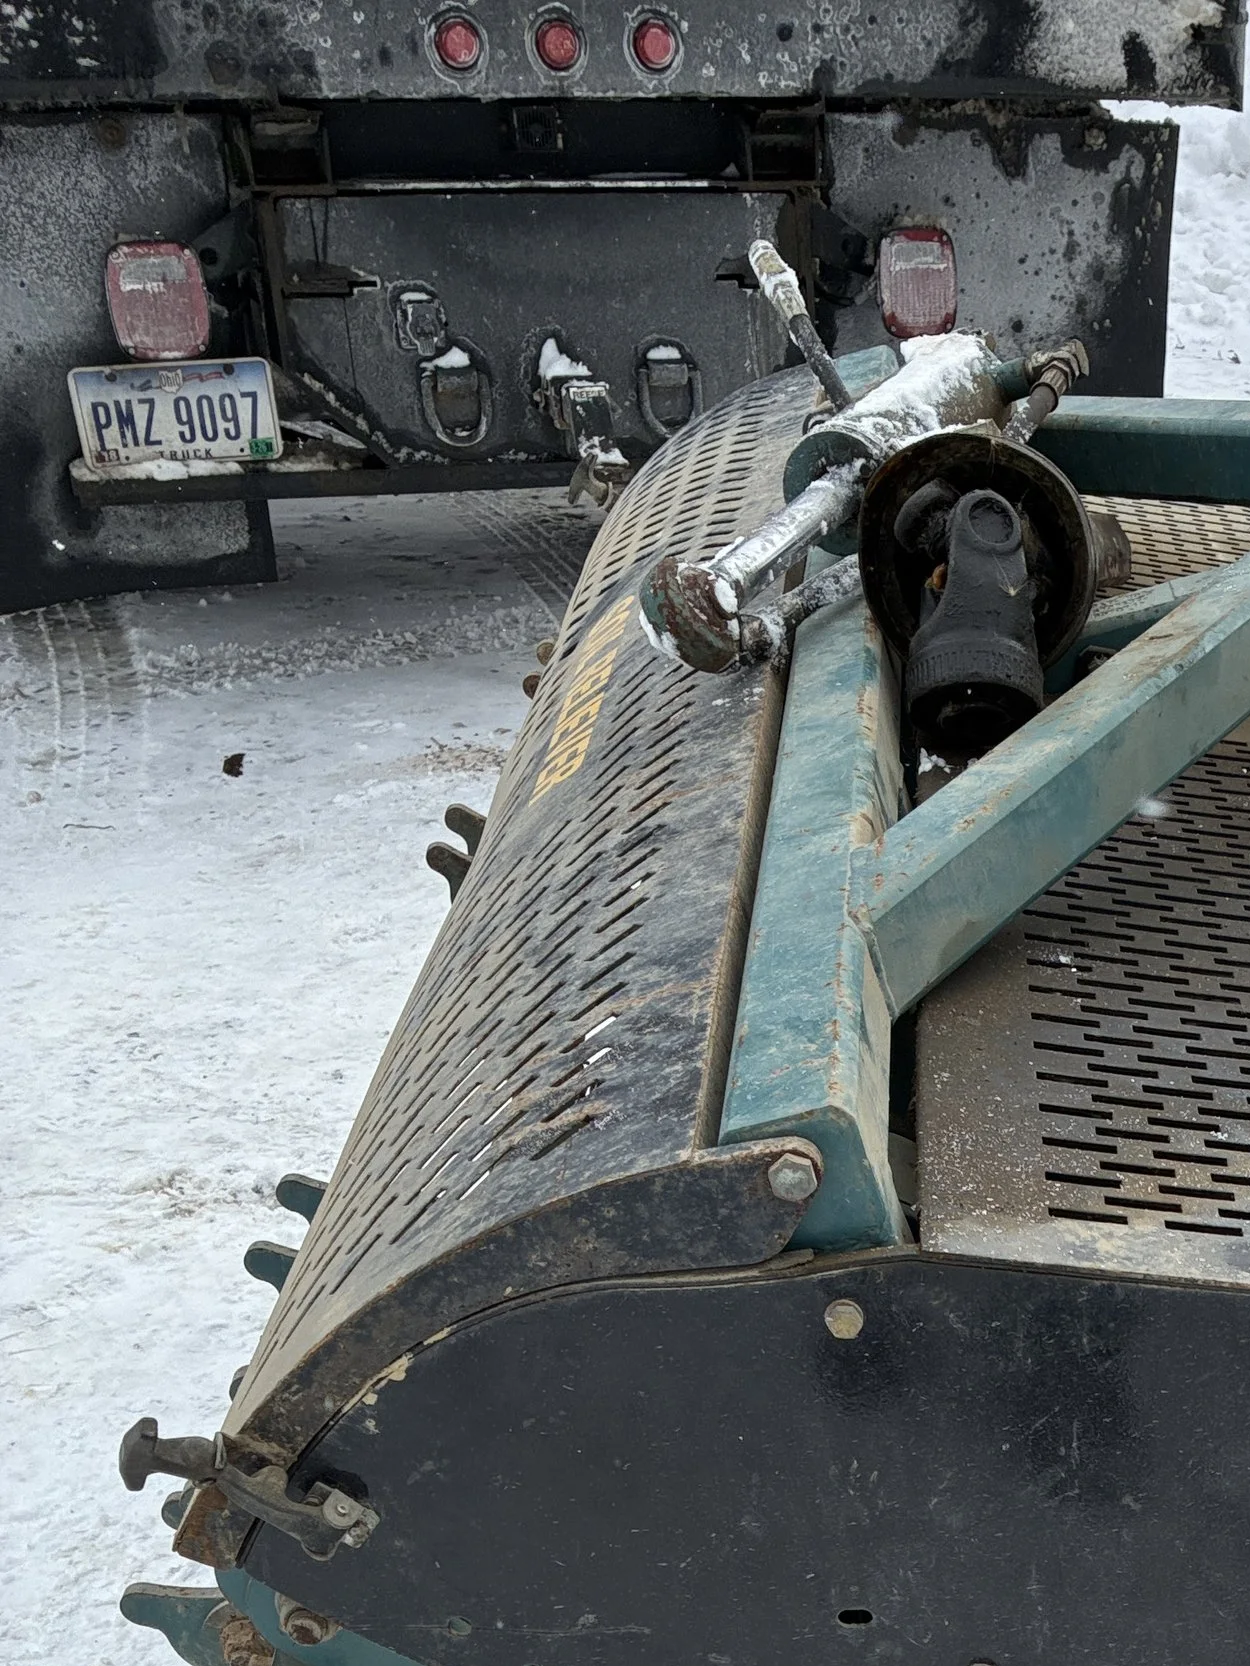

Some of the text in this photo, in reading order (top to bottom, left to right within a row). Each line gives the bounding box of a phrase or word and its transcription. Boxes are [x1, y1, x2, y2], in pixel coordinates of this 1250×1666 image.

[160, 372, 180, 387] Ohio
[91, 390, 258, 452] PMZ 9097
[158, 448, 213, 461] TRUCK
[528, 648, 618, 807] RELIEVER
